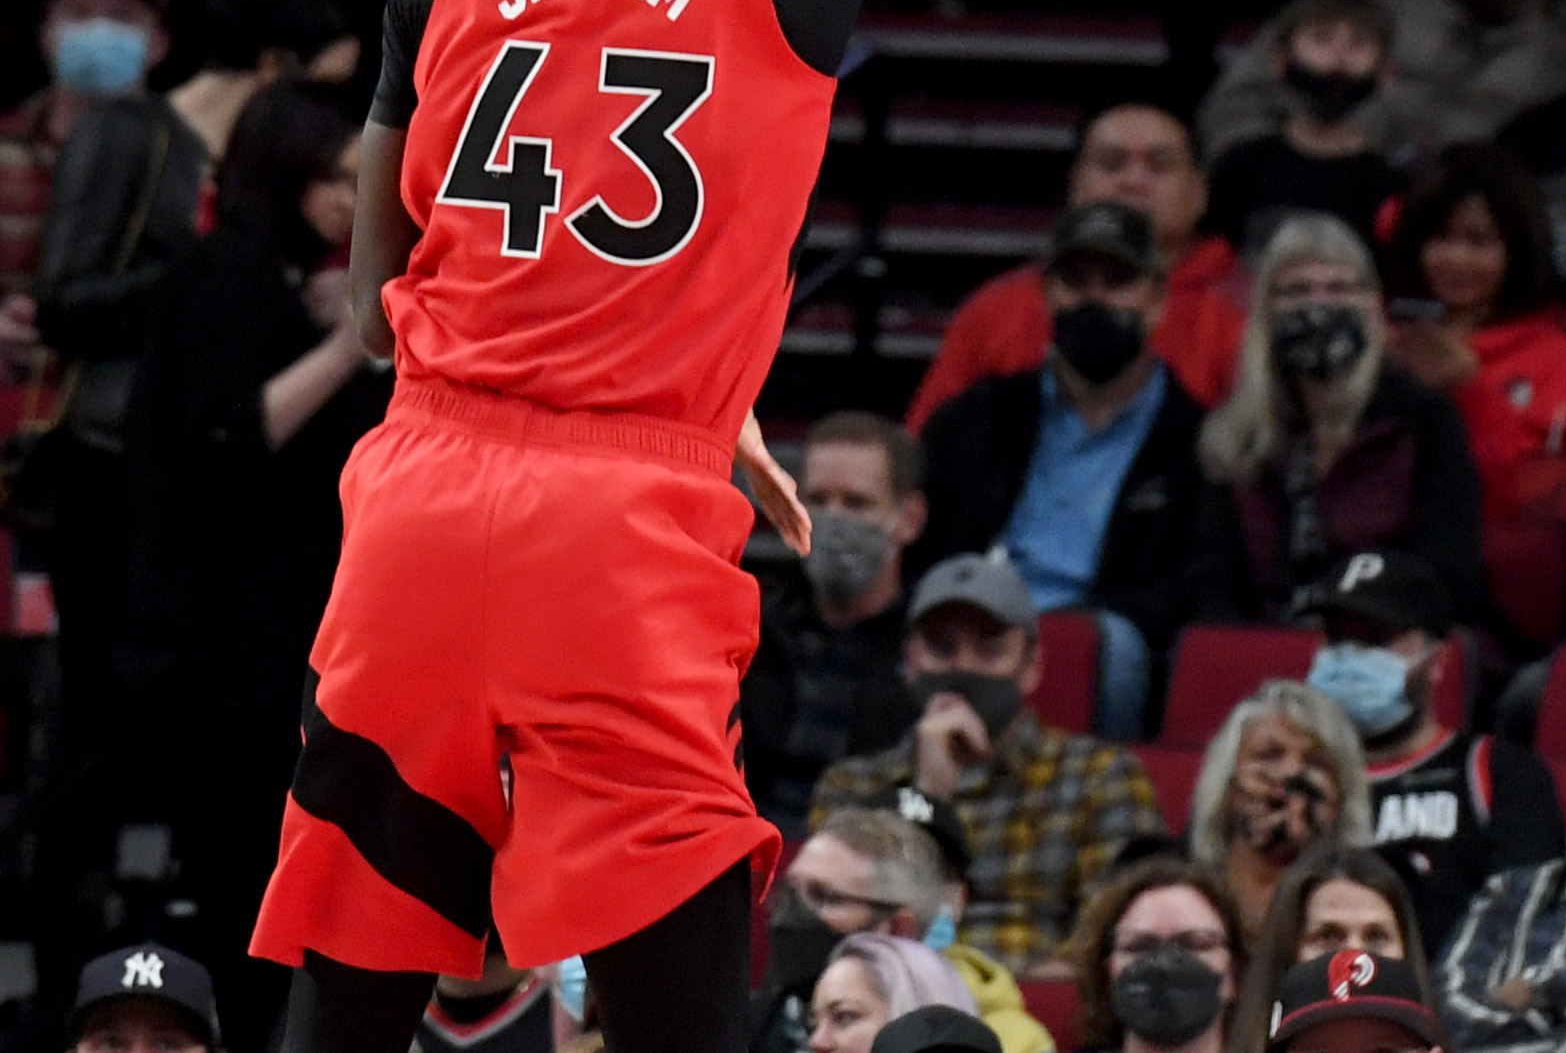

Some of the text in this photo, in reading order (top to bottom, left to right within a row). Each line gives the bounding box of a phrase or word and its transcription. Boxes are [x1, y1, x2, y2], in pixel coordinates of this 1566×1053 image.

[434, 39, 716, 266] 43
[1339, 552, 1385, 593] P
[121, 951, 164, 989] NY
